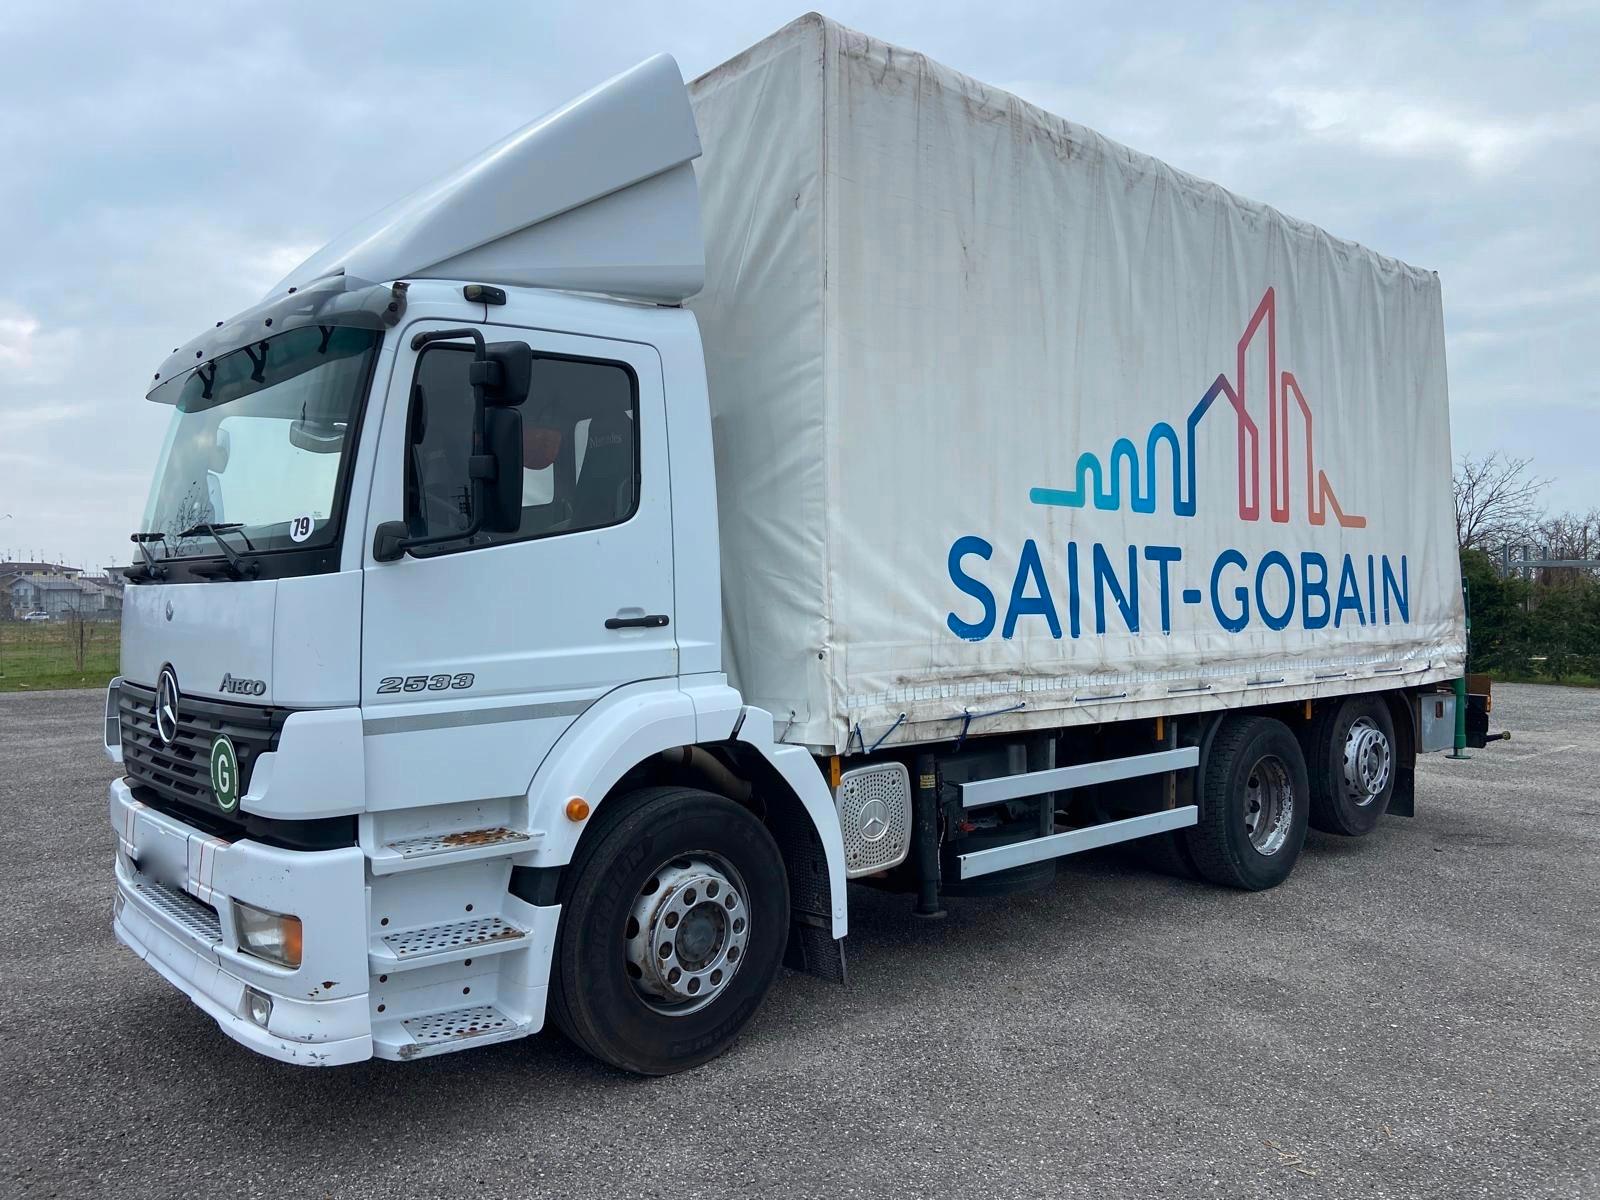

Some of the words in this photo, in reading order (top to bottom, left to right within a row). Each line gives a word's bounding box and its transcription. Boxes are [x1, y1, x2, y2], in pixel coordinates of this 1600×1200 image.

[294, 517, 310, 536] 79
[947, 535, 1409, 642] SAINT-GOBAIN
[376, 673, 475, 694] 2533
[218, 754, 229, 793] G
